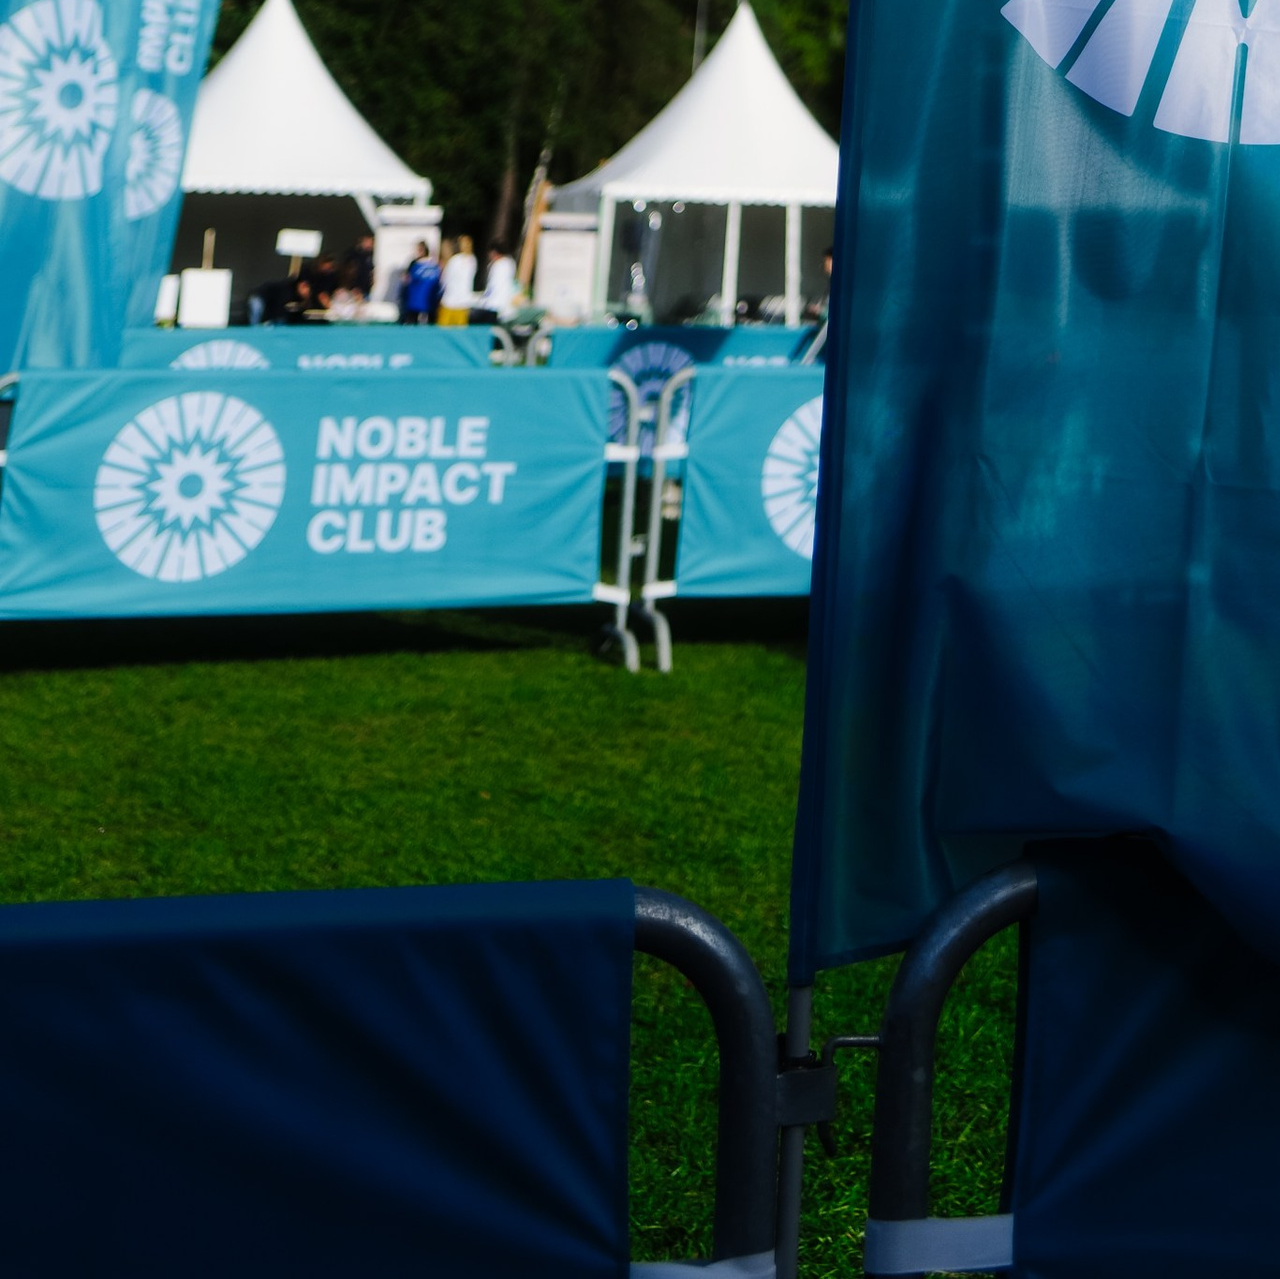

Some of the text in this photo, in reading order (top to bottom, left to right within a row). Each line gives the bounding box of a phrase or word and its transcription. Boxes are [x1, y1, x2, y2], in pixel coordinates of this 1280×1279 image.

[315, 415, 490, 460] NOBLE
[310, 461, 518, 506] IMPACT
[306, 508, 448, 555] CLUB
